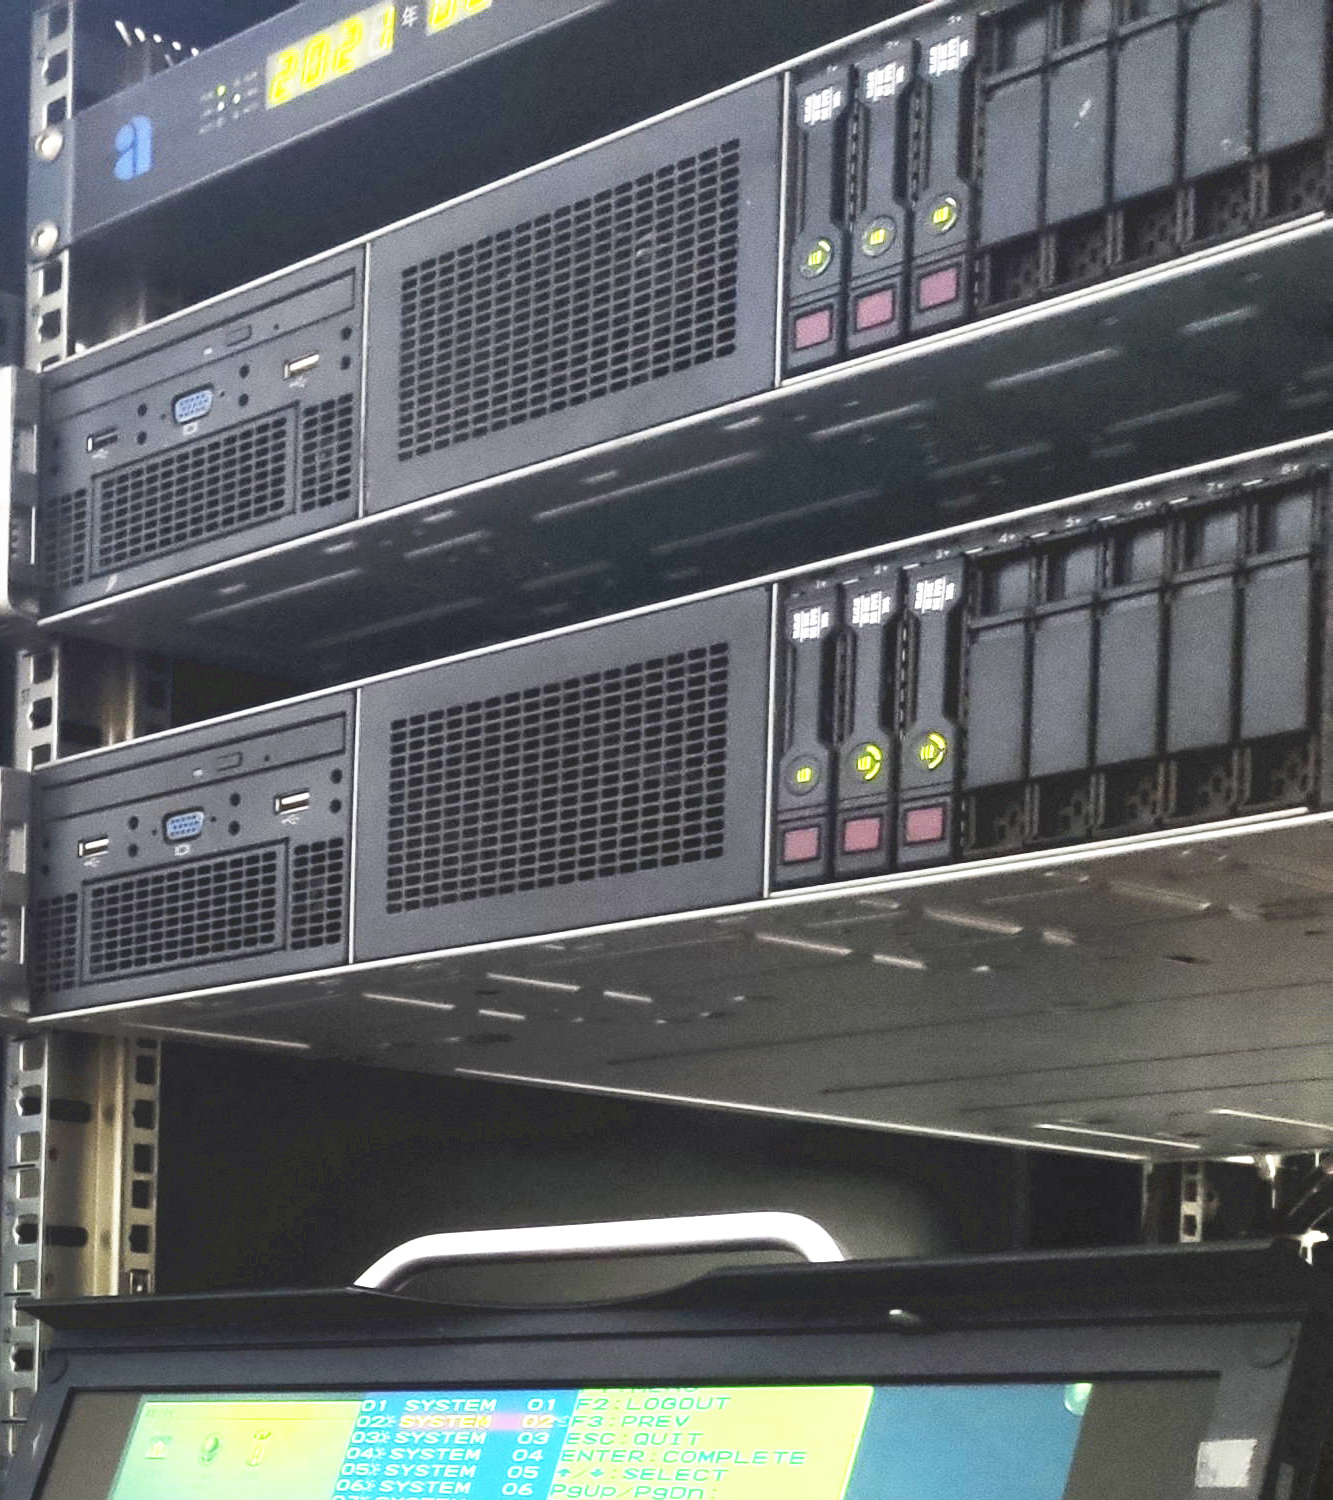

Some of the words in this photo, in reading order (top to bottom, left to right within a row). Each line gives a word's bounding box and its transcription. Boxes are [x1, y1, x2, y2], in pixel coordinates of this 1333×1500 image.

[269, 6, 395, 105] 2021
[362, 1399, 387, 1412] 01
[405, 1399, 497, 1412] SYSTEM
[527, 1399, 556, 1412] 01
[399, 1414, 492, 1429] SYSTEM
[394, 1432, 486, 1445] SYSTEM
[517, 1431, 550, 1445] 03
[389, 1448, 481, 1461] SYSTEM
[512, 1449, 544, 1461] 04
[384, 1464, 476, 1478] SYSTEM
[507, 1466, 539, 1478] 05
[379, 1480, 471, 1494] SYSTEM
[501, 1482, 534, 1495] 06
